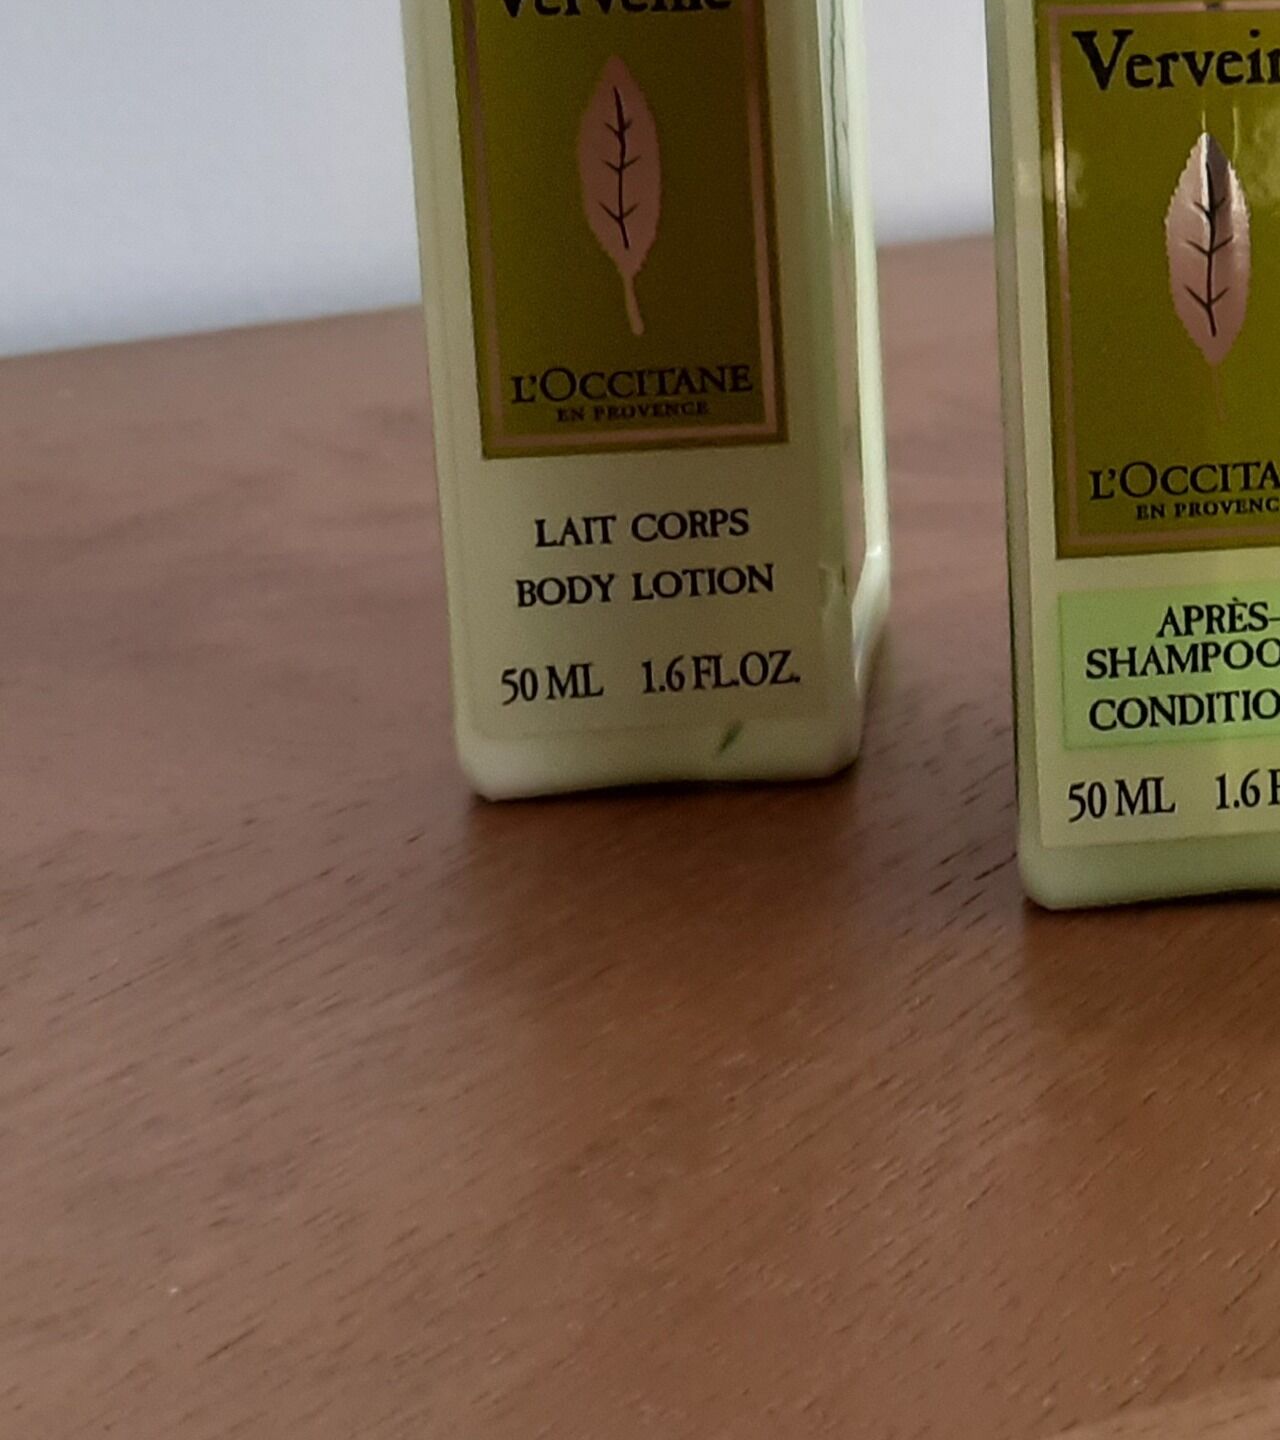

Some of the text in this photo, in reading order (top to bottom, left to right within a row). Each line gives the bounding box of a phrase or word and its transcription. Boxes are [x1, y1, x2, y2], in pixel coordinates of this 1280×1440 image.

[511, 364, 753, 404] L'OCCITANE
[557, 401, 709, 423] EN PROVENCE
[535, 508, 750, 548] LAIT CORPS
[1136, 503, 1165, 521] EN
[516, 564, 775, 607] BODY LOTION
[500, 668, 538, 705] 50
[545, 663, 603, 700] ML
[642, 655, 685, 694] 1.6
[1068, 781, 1107, 823] 50
[1115, 776, 1176, 817] ML
[1215, 769, 1260, 811] 1.6
